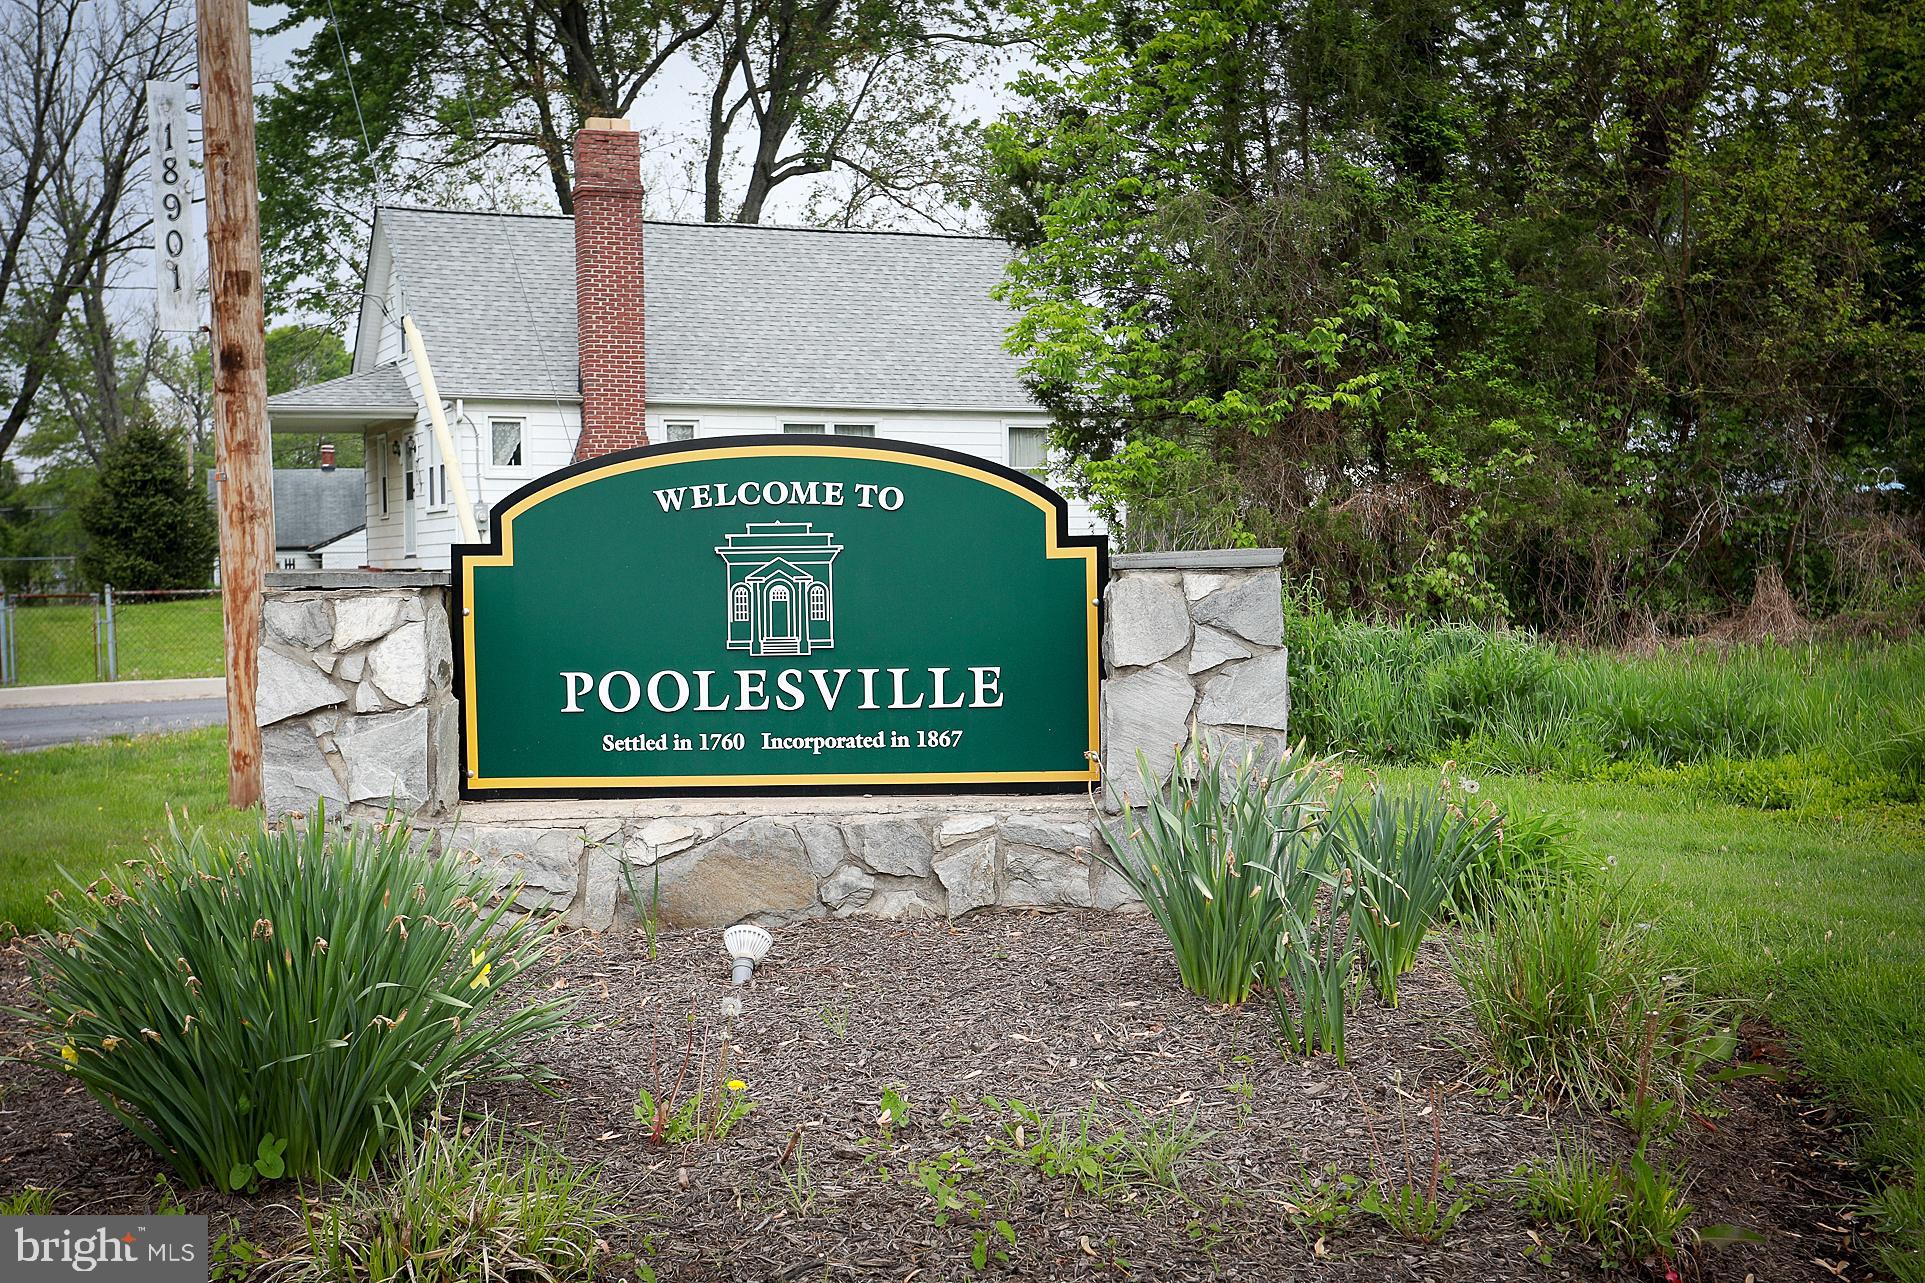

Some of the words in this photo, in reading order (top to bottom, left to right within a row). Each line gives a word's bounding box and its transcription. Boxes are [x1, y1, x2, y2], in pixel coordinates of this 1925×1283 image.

[161, 122, 184, 293] 18901
[652, 480, 845, 513] WELCOME
[854, 483, 905, 511] TO
[559, 666, 1004, 713] POOLESVILLE
[602, 733, 669, 752] Settled
[673, 733, 693, 751] in
[698, 732, 745, 751] 1760
[760, 730, 887, 755] Incorporated
[890, 730, 911, 748] in
[917, 730, 963, 748] 1867
